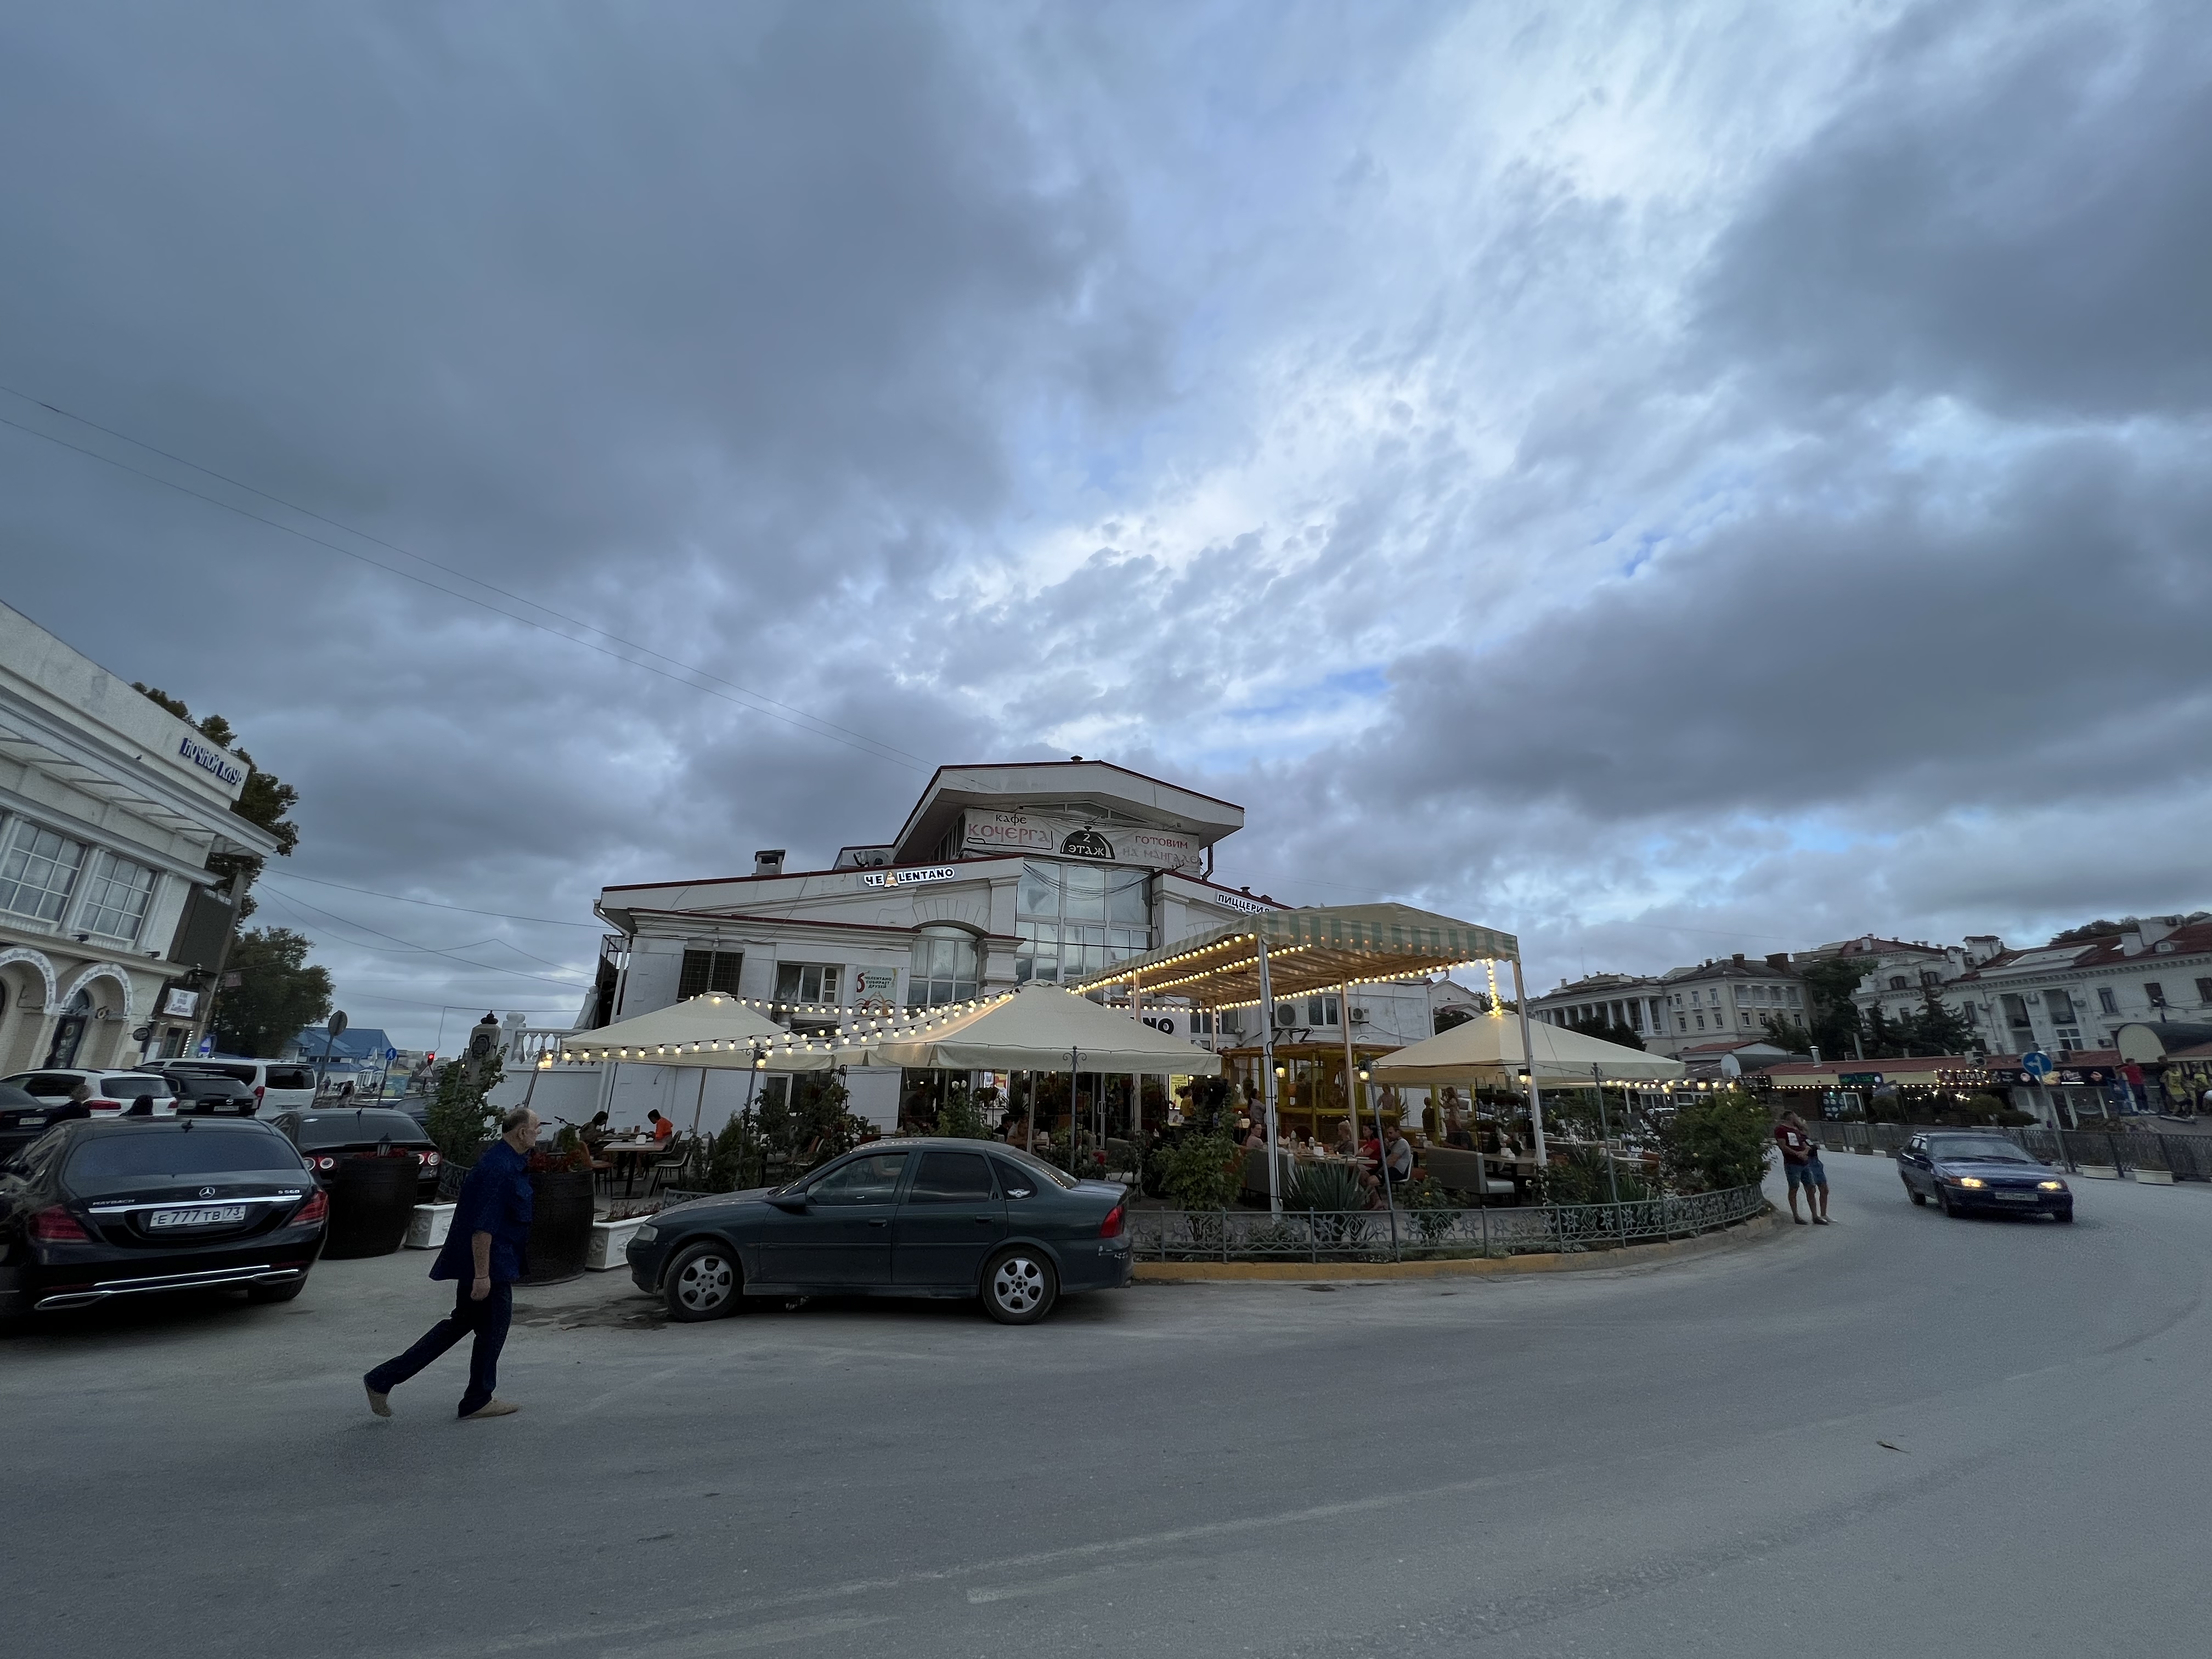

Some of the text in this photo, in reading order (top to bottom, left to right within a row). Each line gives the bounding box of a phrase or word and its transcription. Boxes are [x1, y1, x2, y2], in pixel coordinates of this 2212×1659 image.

[180, 738, 220, 773] НОЧНОЙ
[1083, 833, 1091, 843] 2
[1135, 836, 1188, 849] ГОТОВИМ
[1123, 848, 1139, 857] НА
